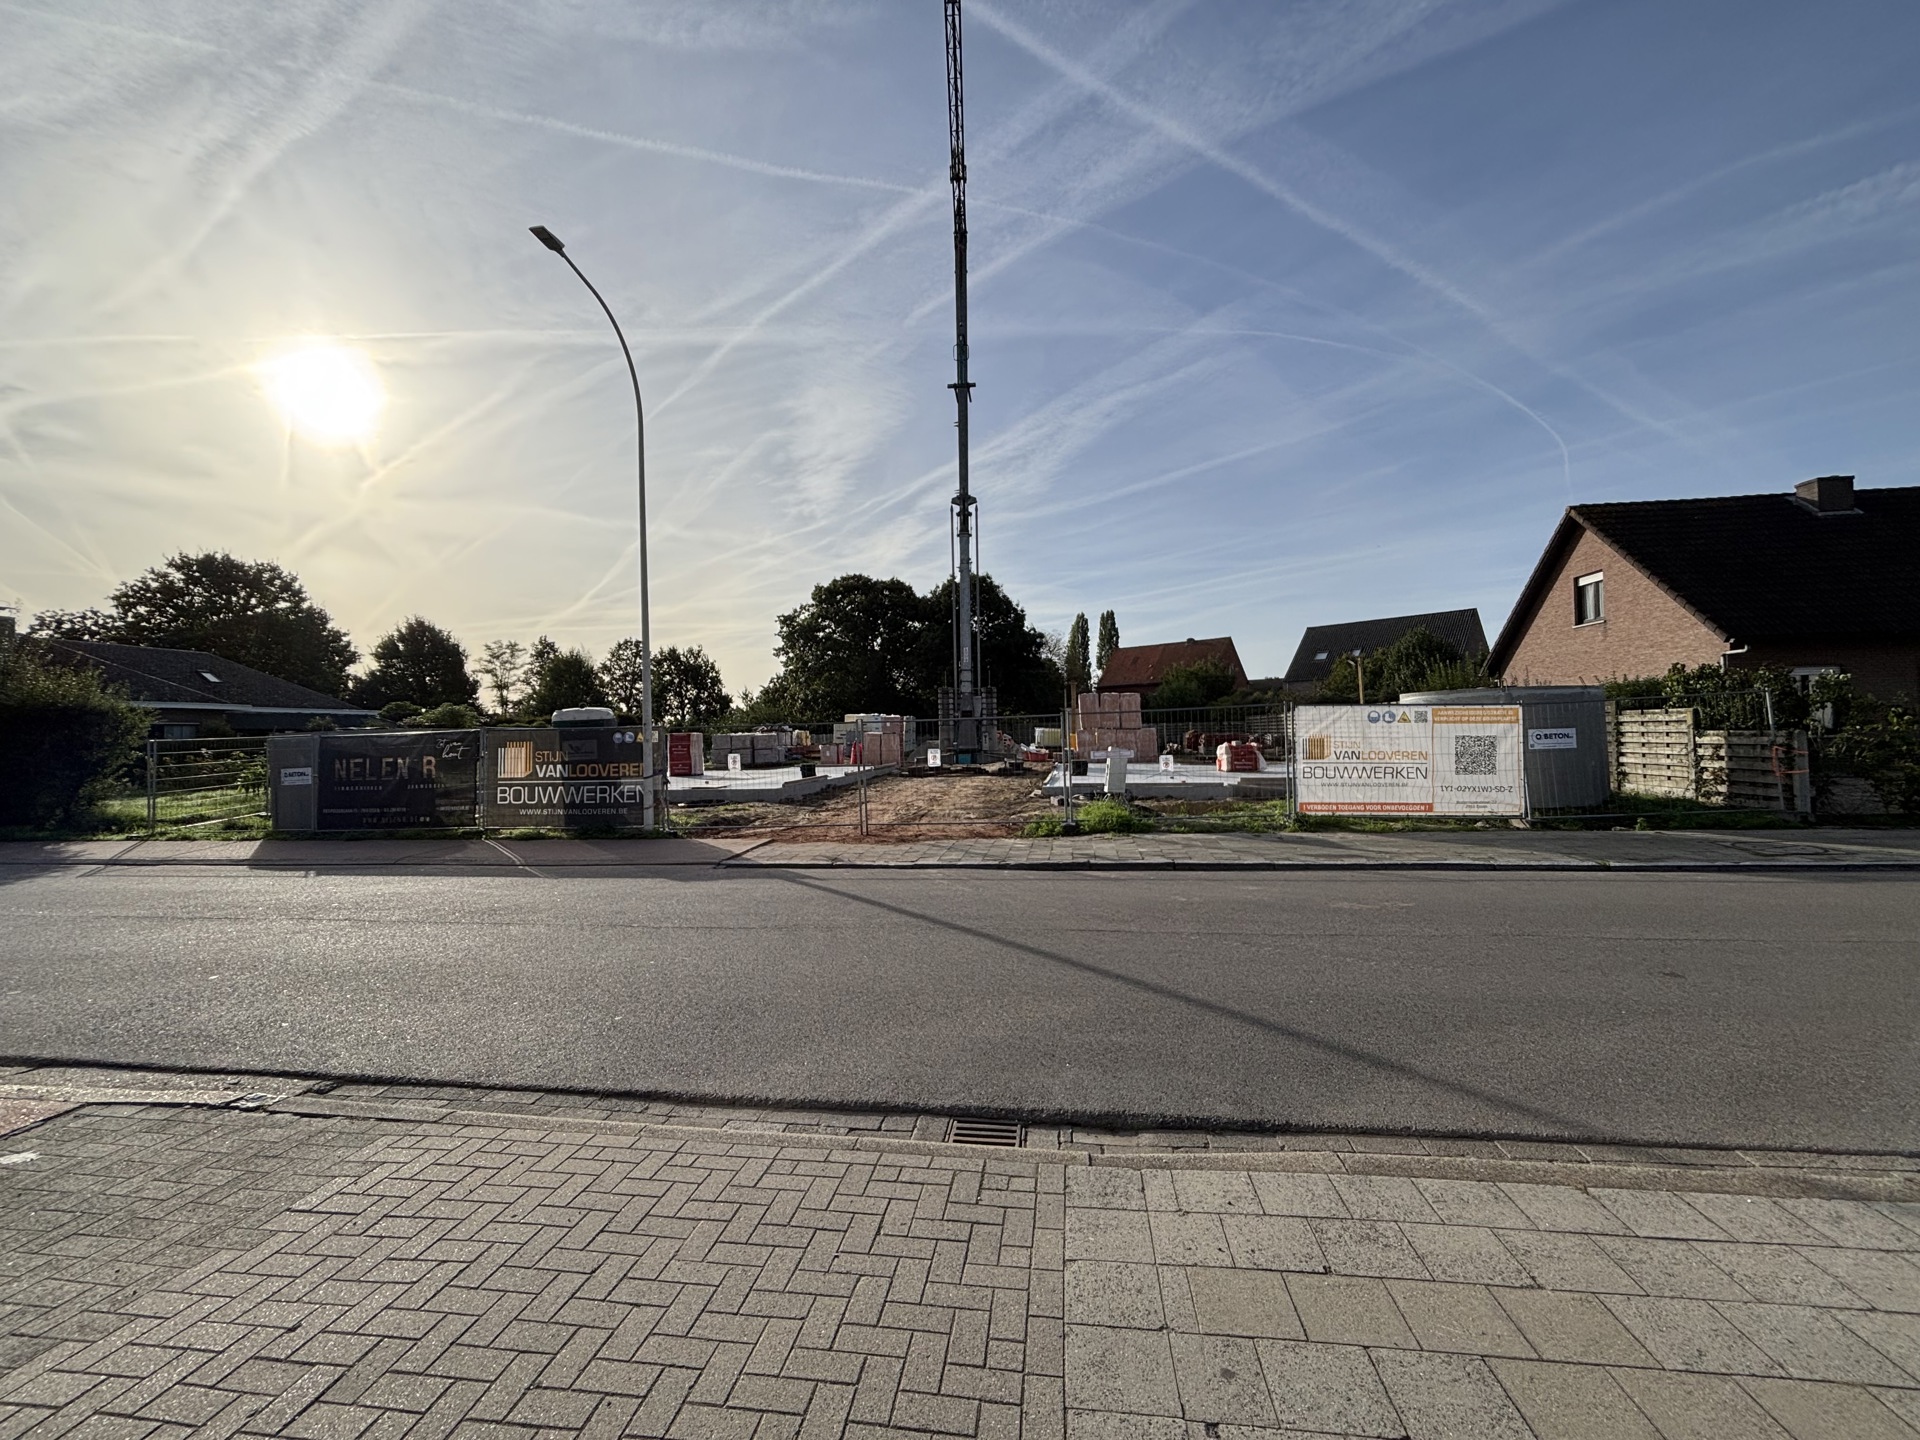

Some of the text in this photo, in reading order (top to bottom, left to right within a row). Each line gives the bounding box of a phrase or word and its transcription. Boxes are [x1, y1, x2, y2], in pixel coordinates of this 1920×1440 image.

[1334, 740, 1361, 749] STIJN
[535, 750, 569, 762] STIJN
[1334, 750, 1428, 760] VANLOOVEREN
[334, 756, 409, 781] NELEN
[1302, 766, 1428, 779] BOUWWERKEN
